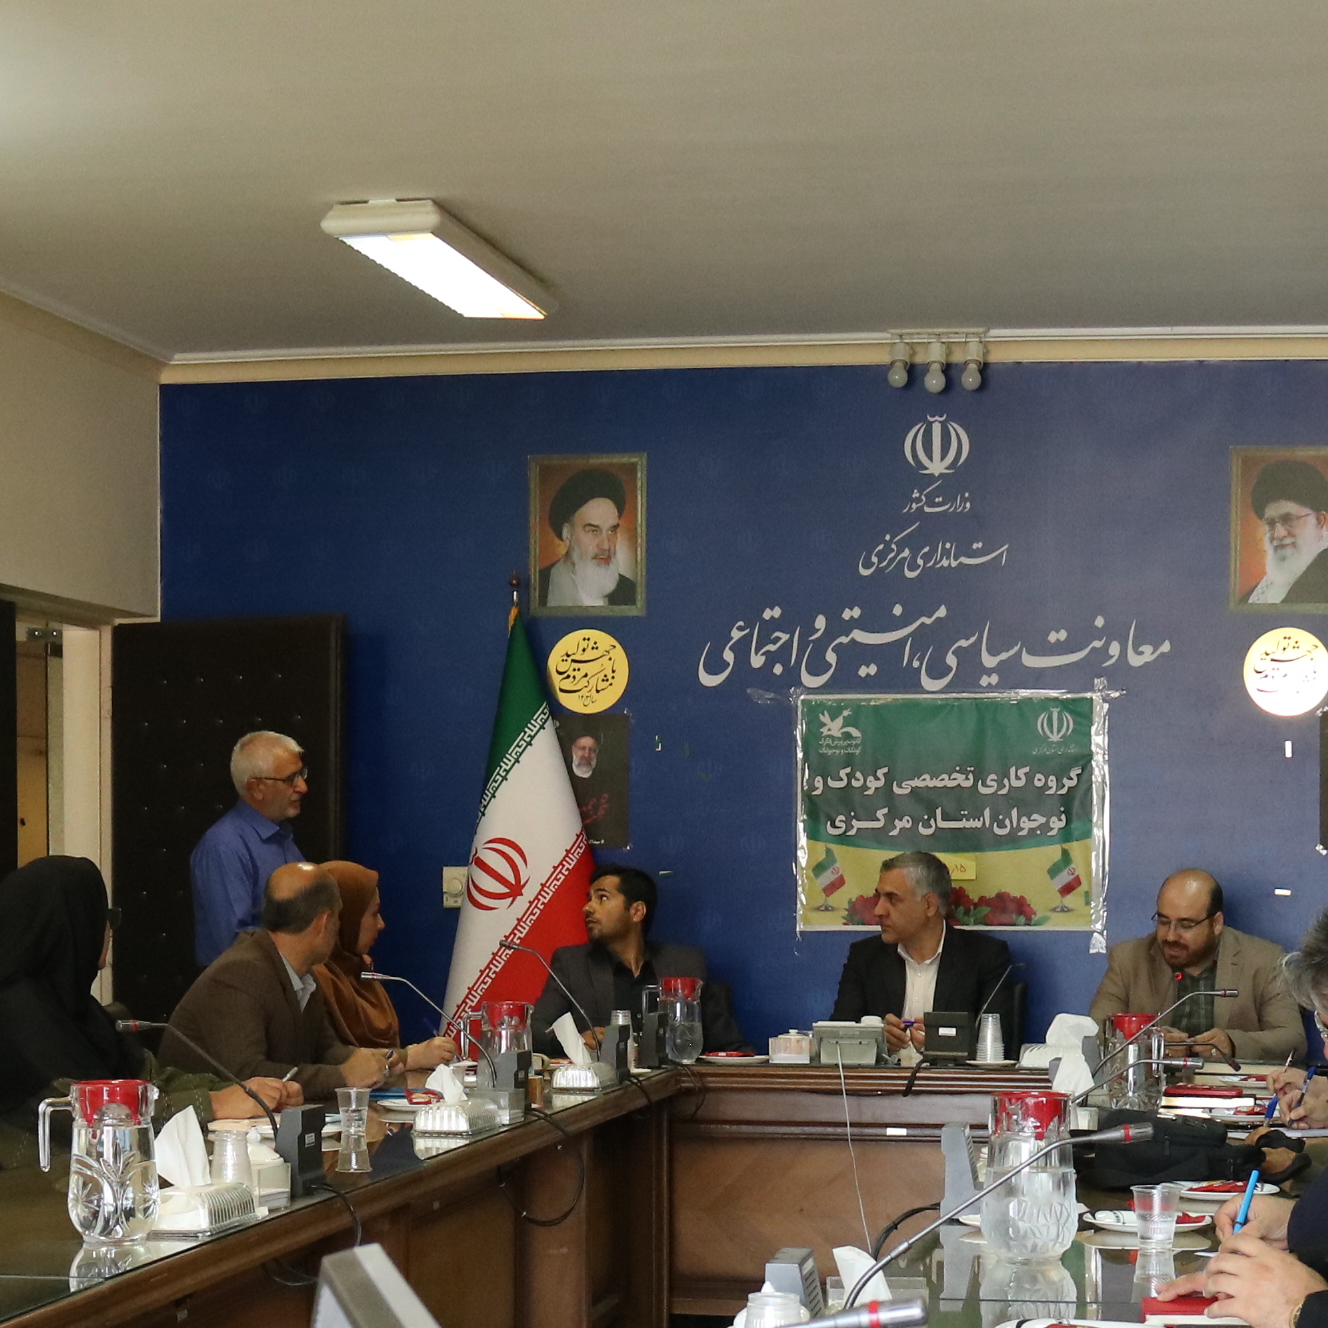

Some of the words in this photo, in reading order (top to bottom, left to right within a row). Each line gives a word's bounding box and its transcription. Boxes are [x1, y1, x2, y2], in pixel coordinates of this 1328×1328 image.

[902, 479, 943, 514] کشور
[923, 492, 971, 513] وزارت
[858, 521, 921, 577] مرکزی
[904, 539, 1010, 579] استانداری
[807, 613, 827, 641] و
[1021, 615, 1172, 668] معاونت
[698, 605, 801, 688] اجتماعی
[800, 603, 948, 688] امنیتی
[811, 775, 824, 795] و
[827, 766, 889, 795] کودک
[892, 765, 975, 795] تخصصی
[977, 765, 1031, 795] کاری
[1033, 766, 1083, 795] گروه
[826, 806, 913, 836] مرکزی
[918, 806, 991, 836] استان
[993, 806, 1067, 836] نوجوان
